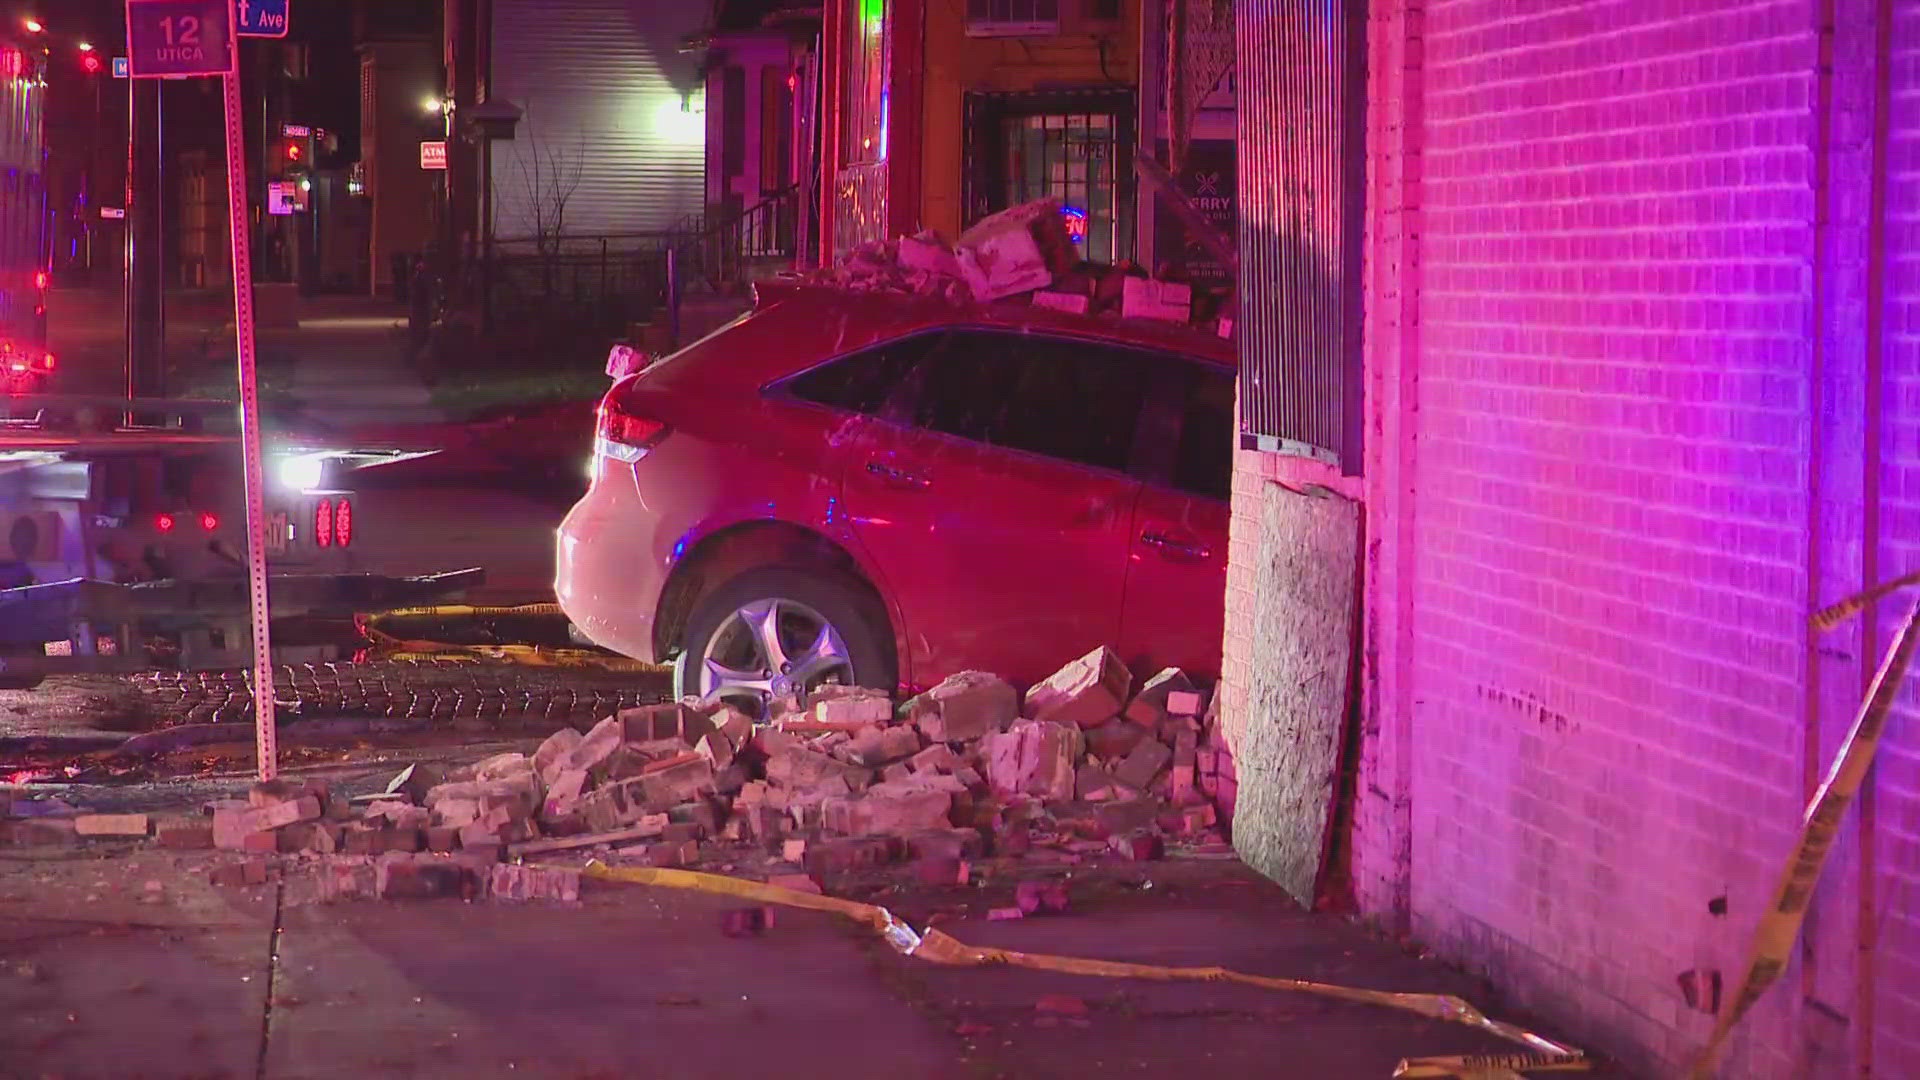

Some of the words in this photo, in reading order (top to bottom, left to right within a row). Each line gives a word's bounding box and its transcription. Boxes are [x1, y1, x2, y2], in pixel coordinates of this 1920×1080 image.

[238, 0, 249, 27] t
[258, 9, 284, 28] Ave
[159, 15, 199, 46] 12
[156, 47, 204, 62] UTICA
[423, 147, 446, 157] ATM
